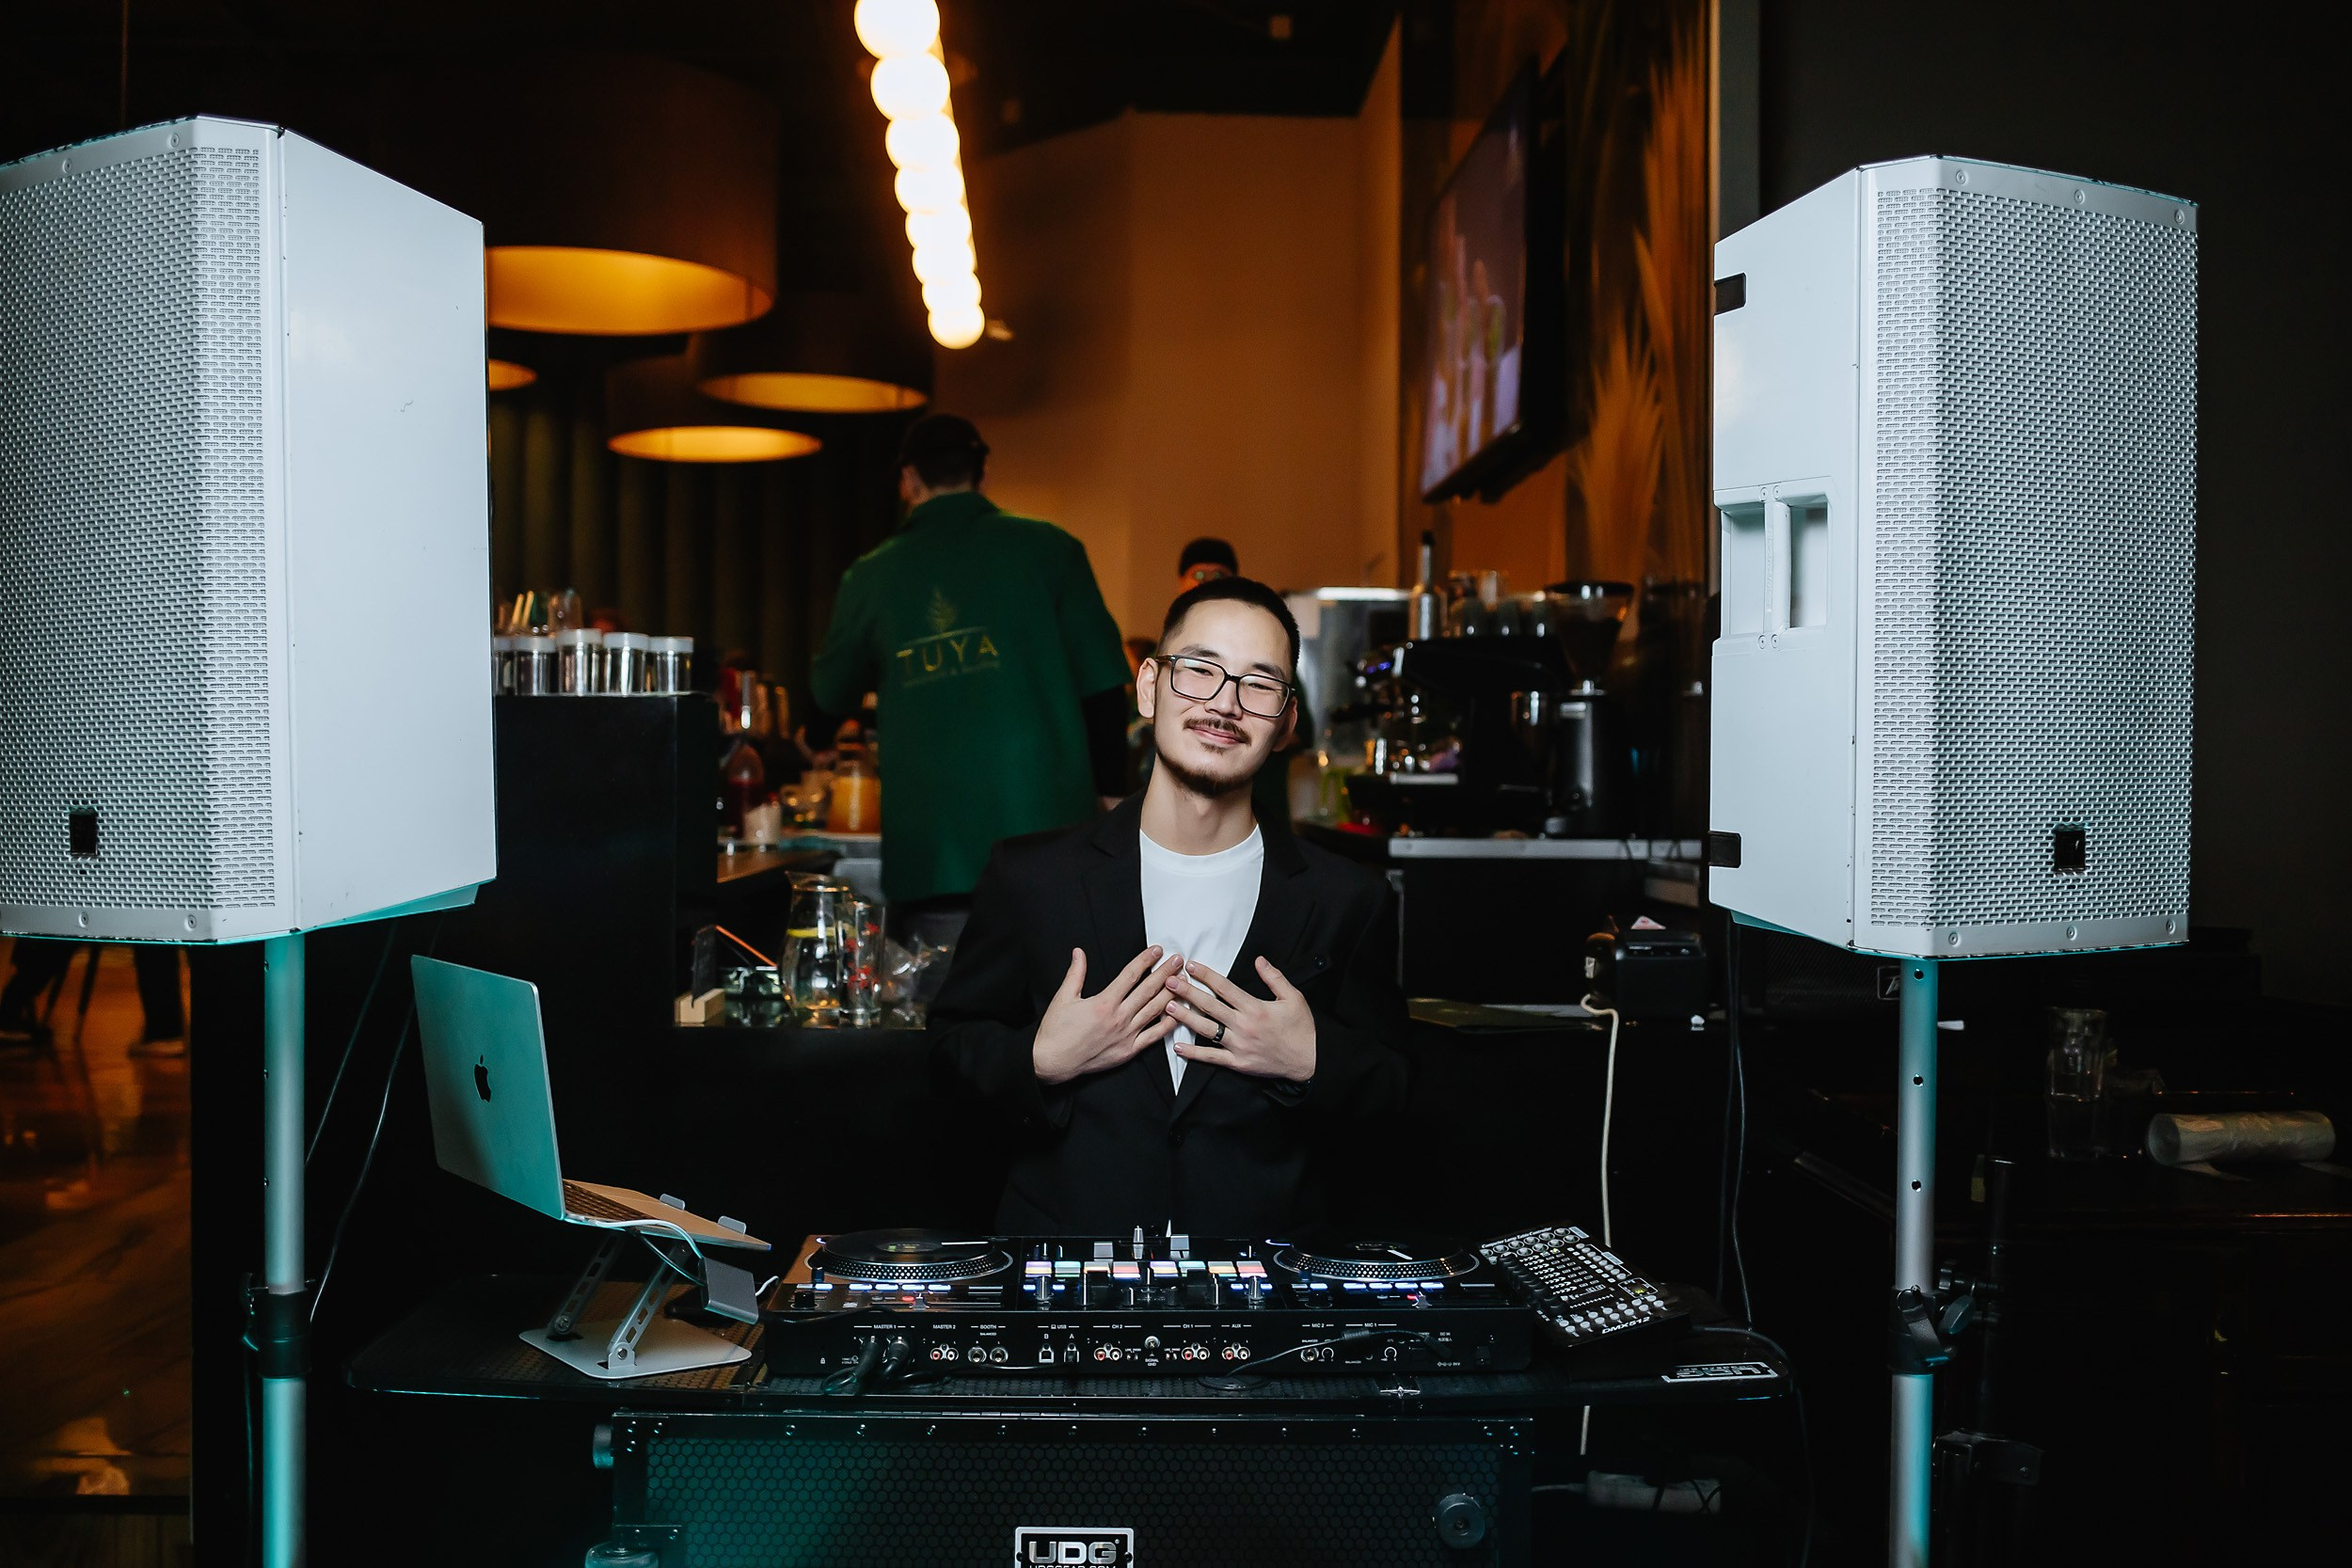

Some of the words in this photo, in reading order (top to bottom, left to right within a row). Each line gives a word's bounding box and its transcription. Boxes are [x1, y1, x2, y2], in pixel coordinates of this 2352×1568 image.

[896, 634, 998, 676] TUYA
[1601, 1316, 1651, 1335] DMX512
[1028, 1541, 1117, 1564] UDG
